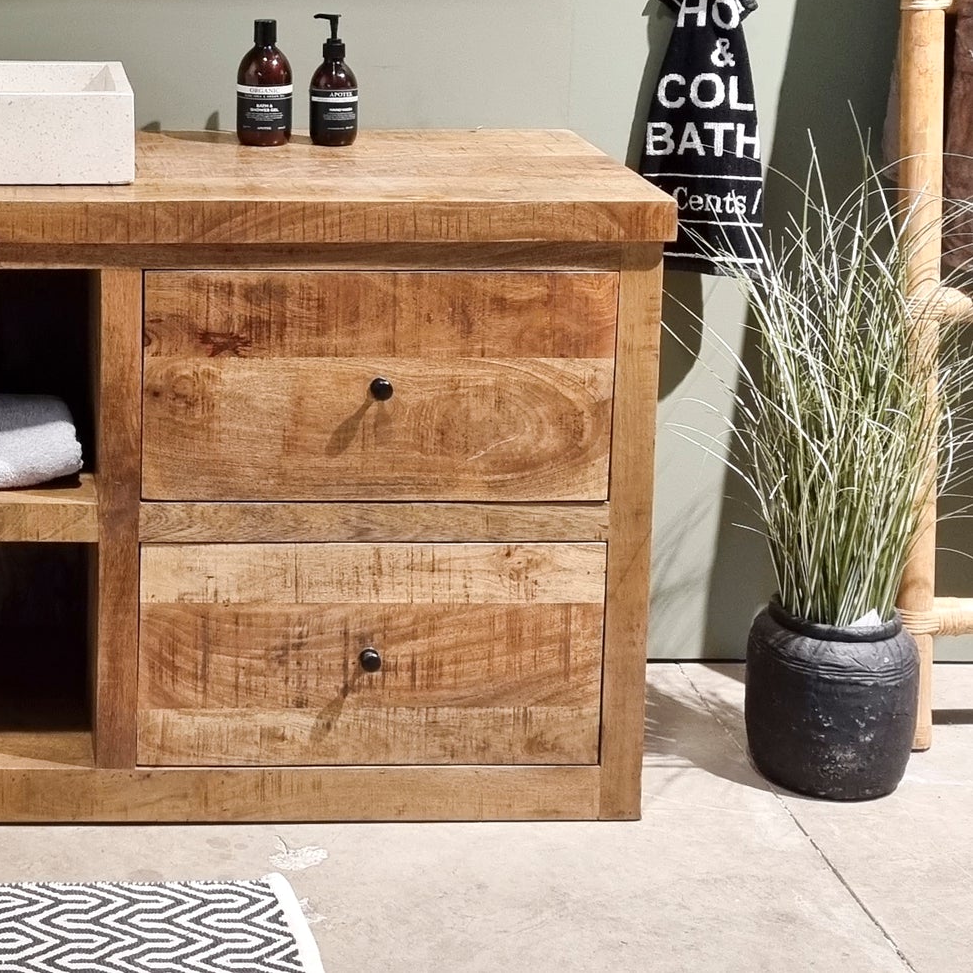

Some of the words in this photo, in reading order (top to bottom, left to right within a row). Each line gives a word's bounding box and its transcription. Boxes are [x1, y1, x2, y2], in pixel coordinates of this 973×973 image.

[710, 37, 736, 67] &
[646, 121, 761, 159] BATH
[672, 186, 747, 215] Cents
